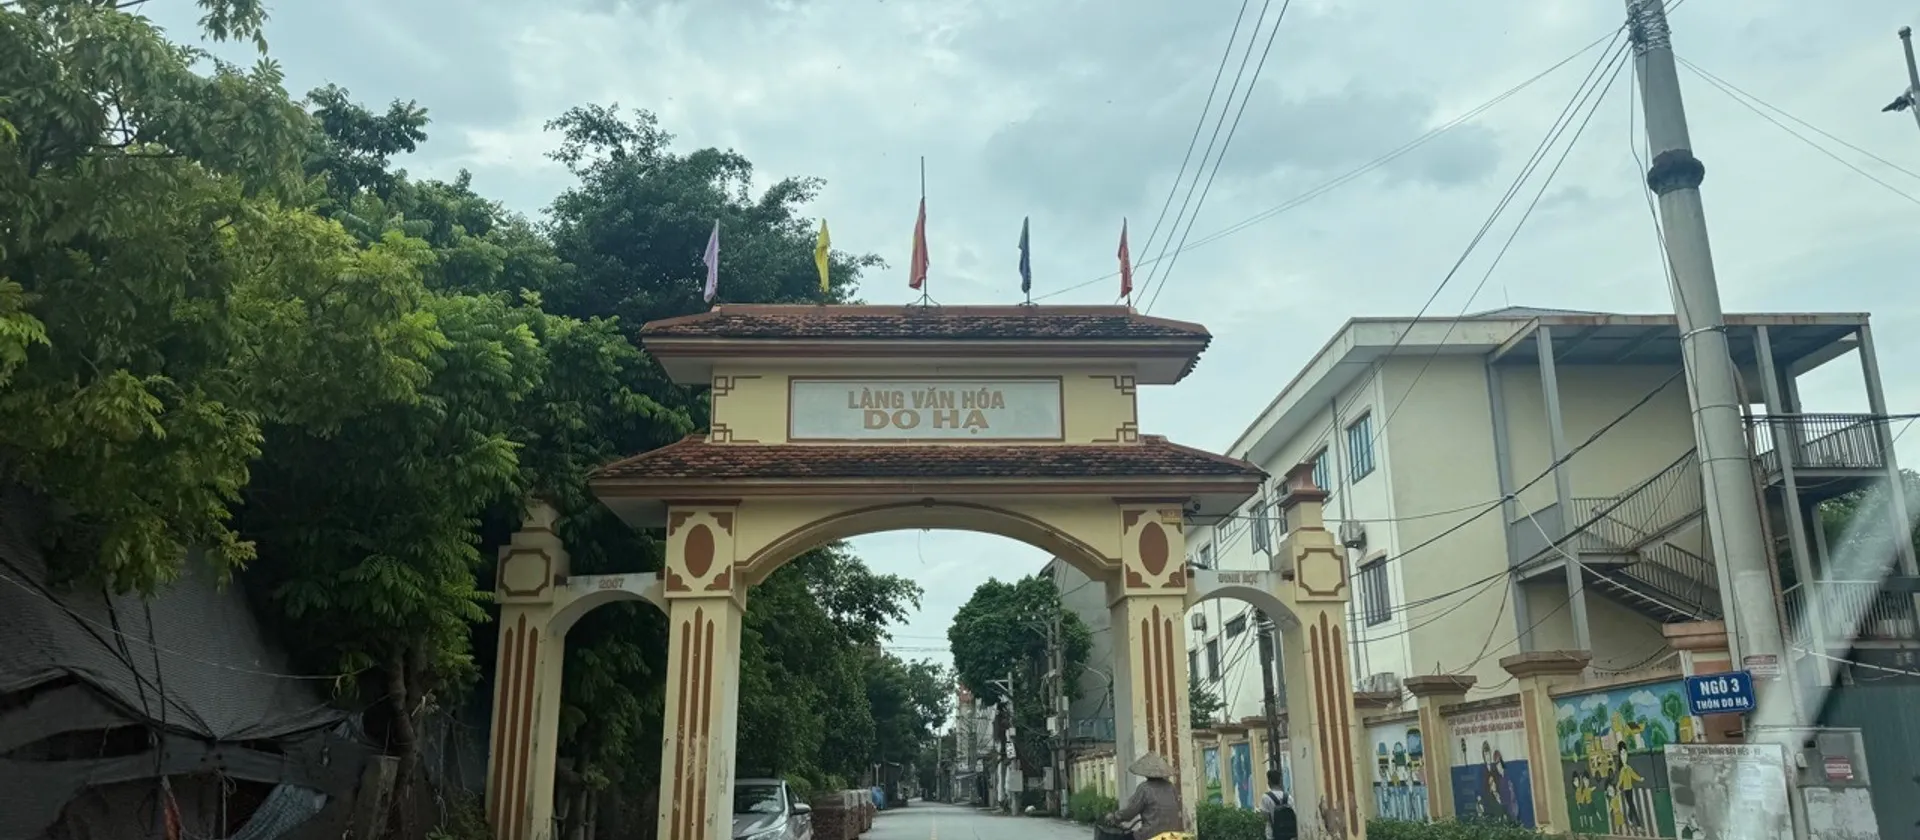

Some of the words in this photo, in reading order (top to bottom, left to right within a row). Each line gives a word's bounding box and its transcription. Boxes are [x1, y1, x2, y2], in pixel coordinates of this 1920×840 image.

[848, 387, 904, 409] LÀNG
[912, 387, 955, 409] VĂN
[962, 387, 1005, 409] HÓA
[864, 409, 921, 429] DO
[933, 409, 989, 434] HẠ
[598, 577, 625, 589] 2007
[1700, 677, 1728, 695] NGÕ
[1731, 678, 1740, 692] 3
[1696, 698, 1720, 710] THÔN
[1736, 696, 1749, 708] HẠ
